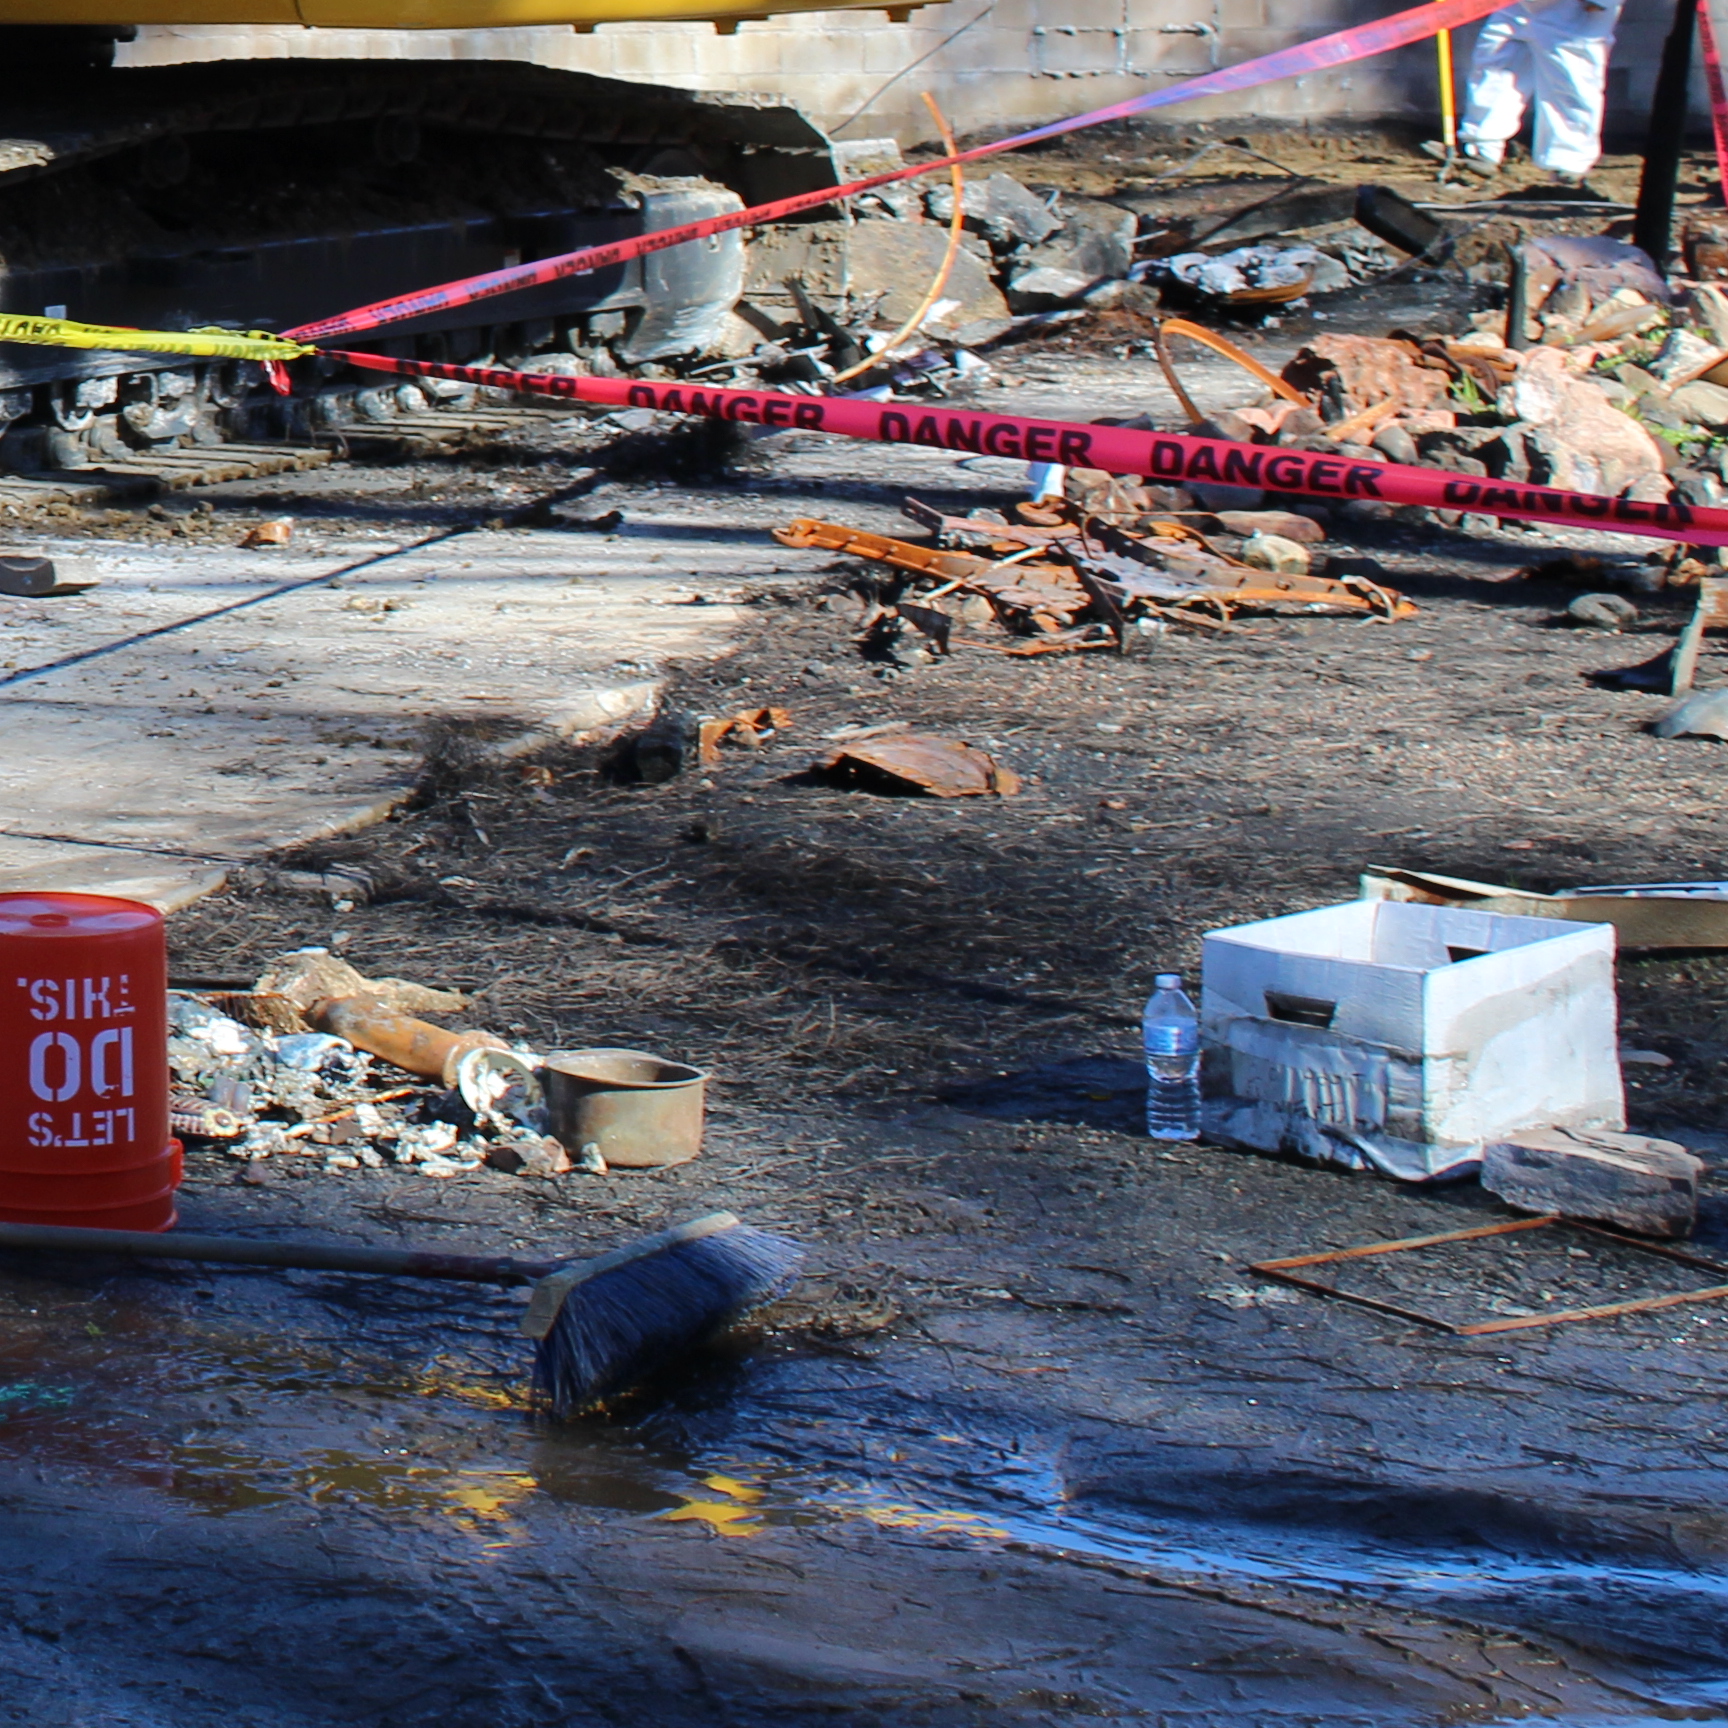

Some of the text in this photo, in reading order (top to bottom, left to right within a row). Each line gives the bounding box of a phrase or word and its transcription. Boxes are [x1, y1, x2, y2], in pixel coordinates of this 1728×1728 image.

[628, 386, 826, 429] DANGER
[879, 411, 1094, 468] DANGER
[1151, 440, 1384, 498] DANGER
[1442, 481, 1696, 531] DANGER
[28, 1027, 134, 1103] DO
[28, 1108, 135, 1147] LET'S
